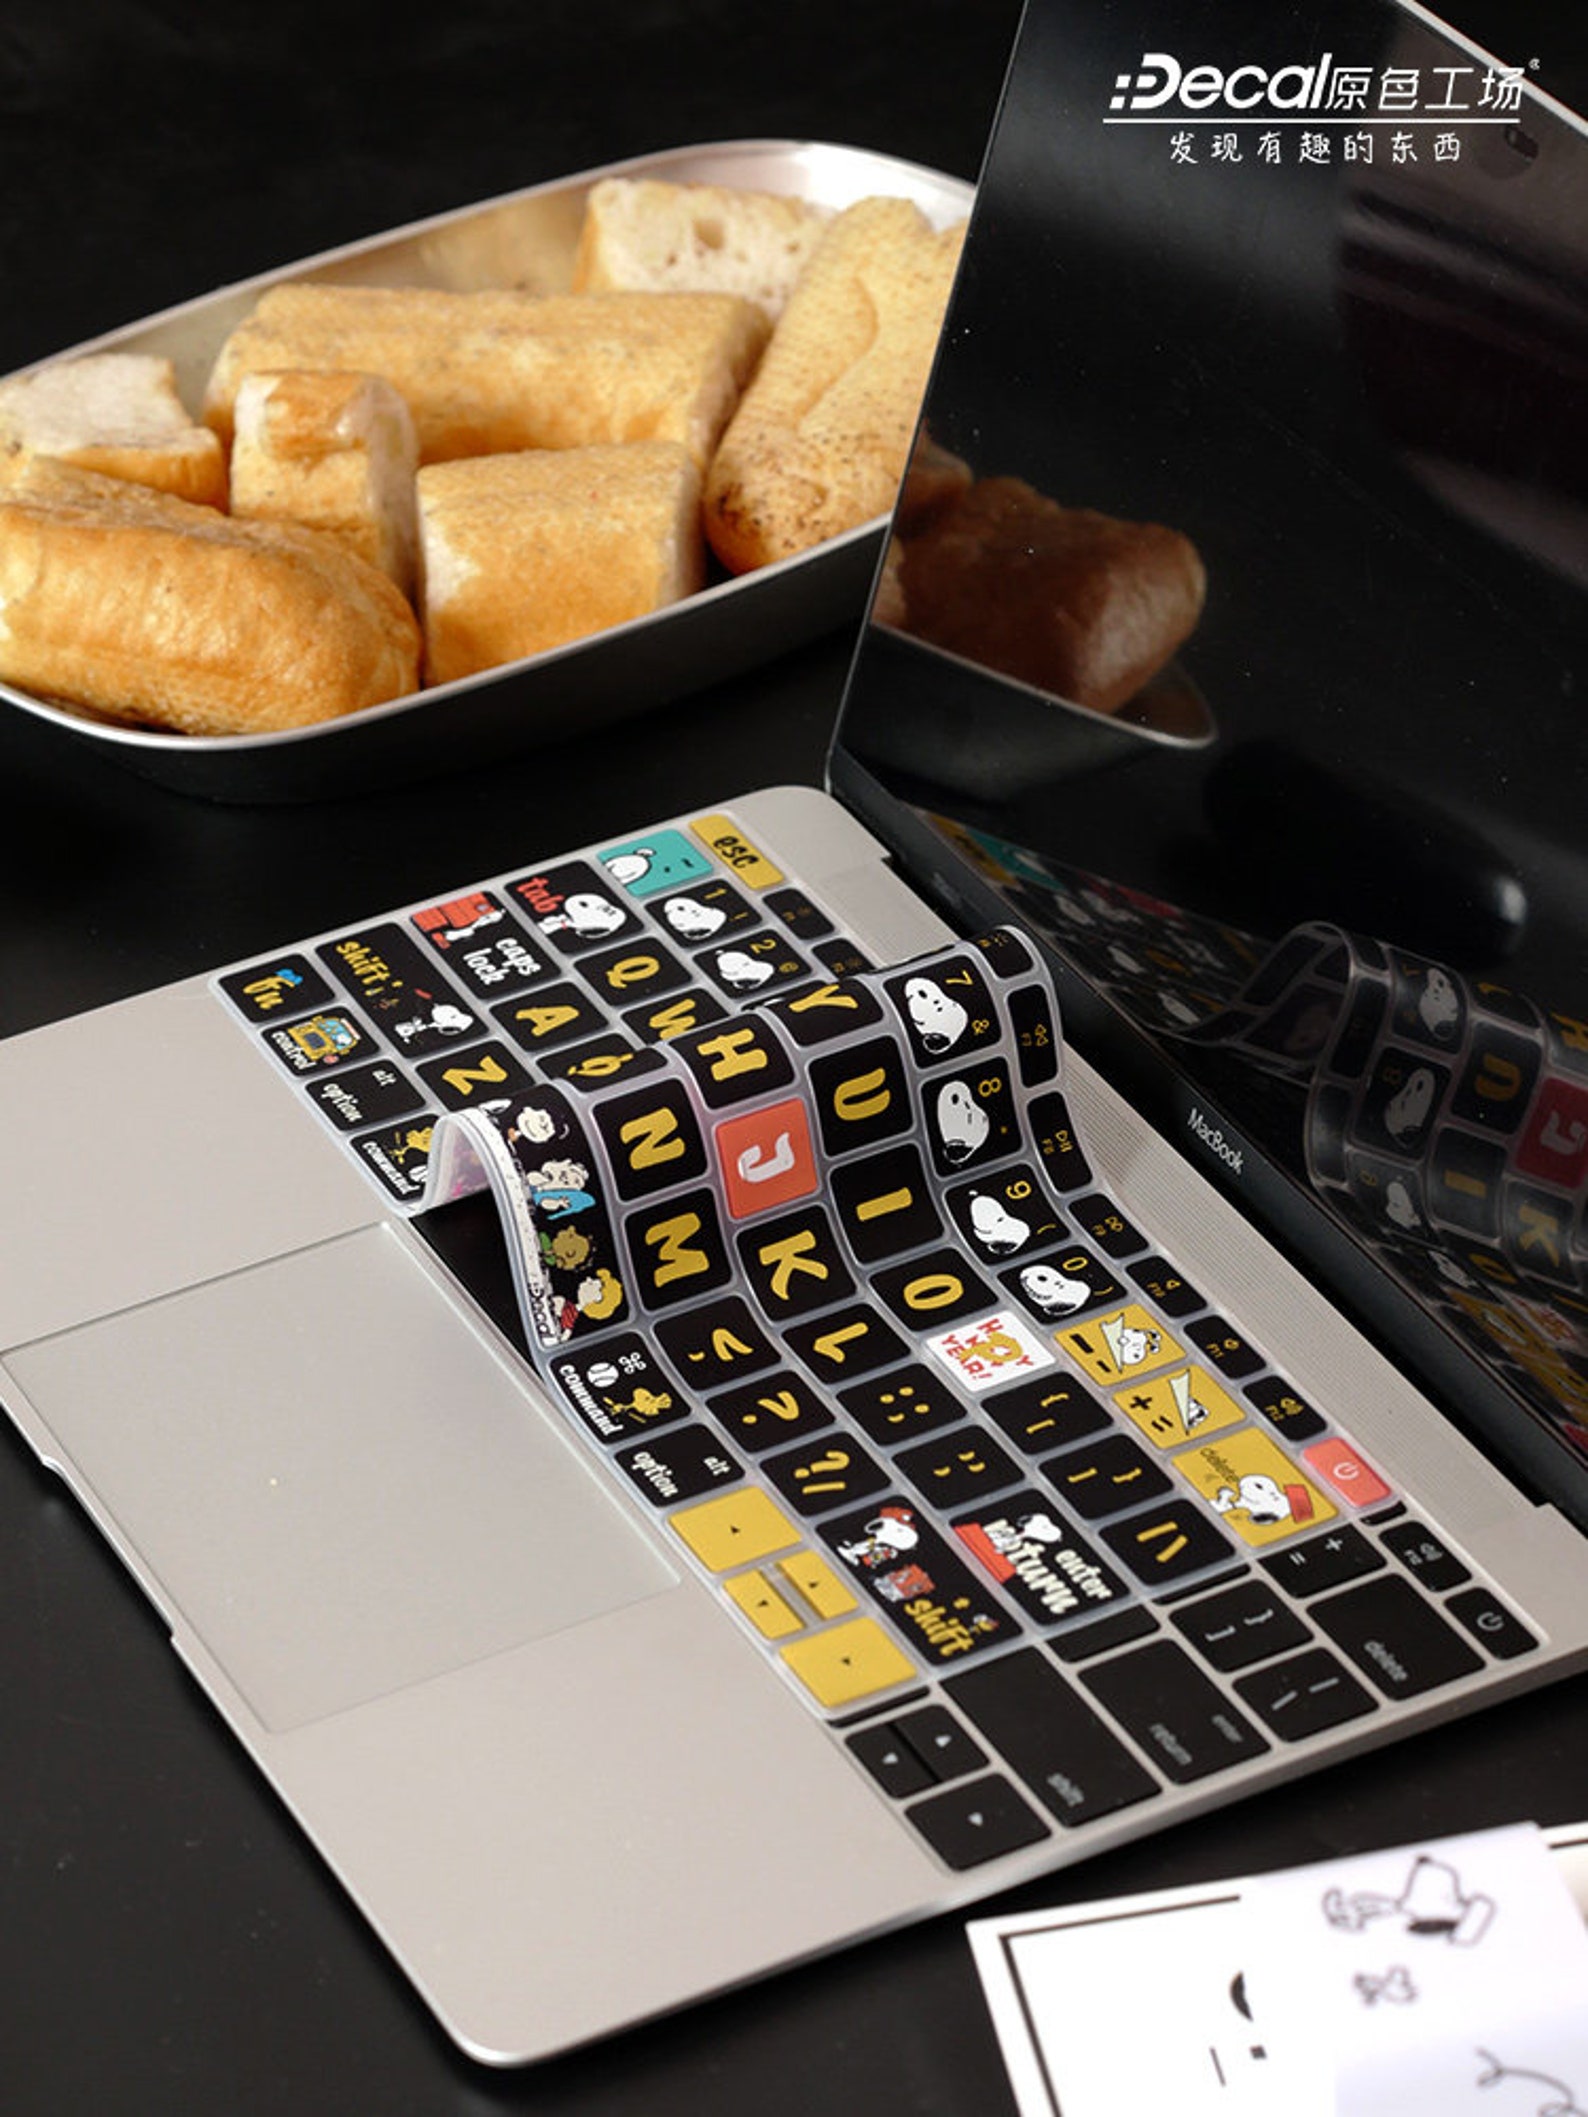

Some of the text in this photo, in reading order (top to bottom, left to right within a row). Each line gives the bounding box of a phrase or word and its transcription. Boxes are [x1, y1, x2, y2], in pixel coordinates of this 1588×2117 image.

[713, 835, 759, 869] esc
[517, 877, 565, 914] tab
[336, 941, 391, 988] shift
[463, 948, 506, 985] lock
[495, 937, 541, 977] caps
[750, 939, 777, 954] 2
[607, 956, 660, 988] Q
[945, 970, 974, 986] 7
[515, 1005, 580, 1037] A
[697, 1028, 768, 1082] H
[442, 1056, 507, 1096] Z
[834, 1067, 891, 1121] U
[977, 1077, 1002, 1097] 8
[323, 1082, 363, 1123] option
[620, 1107, 686, 1170] N
[738, 1132, 795, 1183] J
[1187, 1108, 1243, 1174] MacBook
[1005, 1180, 1032, 1200] 9
[645, 1212, 710, 1288] M
[759, 1230, 829, 1300] K
[1062, 1256, 1089, 1272] 0
[903, 1274, 964, 1309] O
[814, 1322, 869, 1363] L
[559, 1364, 623, 1437] command
[633, 1451, 678, 1498] option
[703, 1456, 731, 1477] alt
[1055, 1549, 1113, 1599] enter
[904, 1600, 974, 1656] shift
